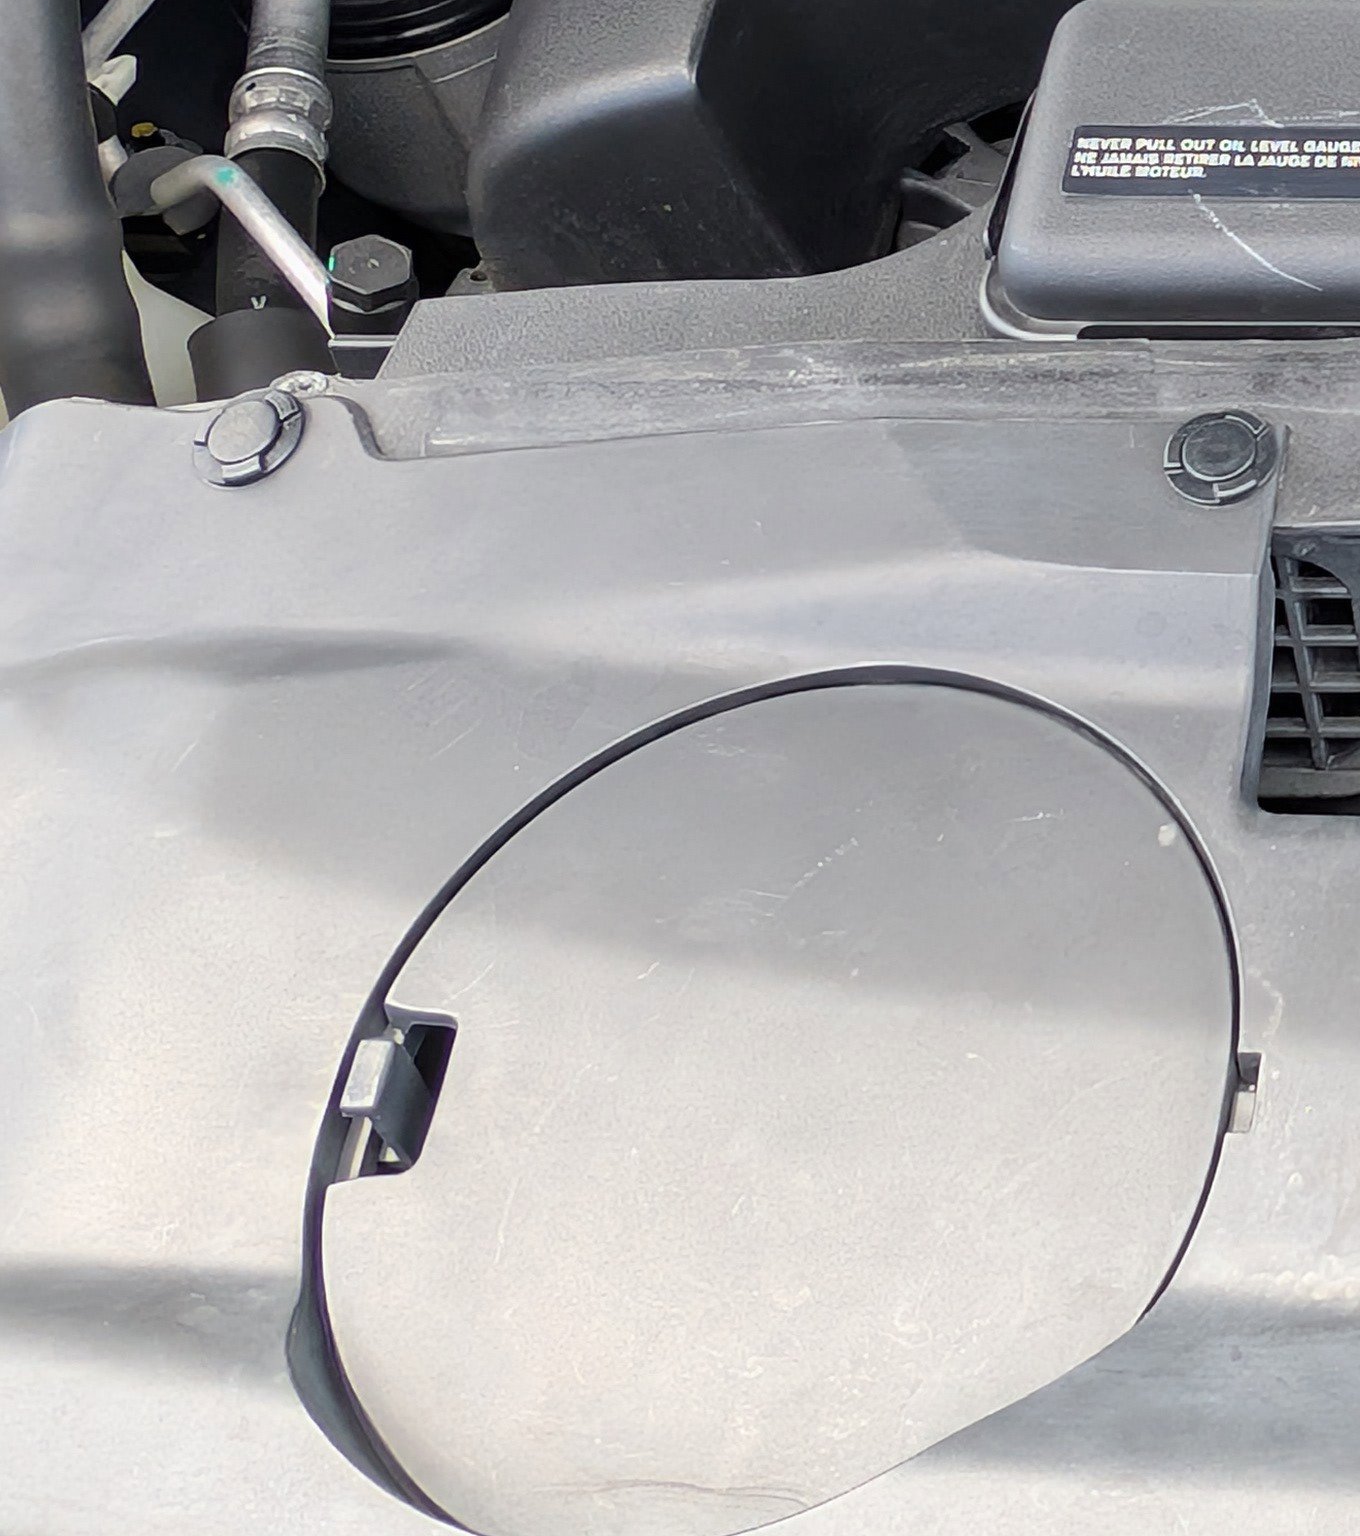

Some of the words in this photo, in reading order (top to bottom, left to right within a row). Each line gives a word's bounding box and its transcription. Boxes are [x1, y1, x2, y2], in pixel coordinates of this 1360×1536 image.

[1135, 139, 1175, 150] PULL
[1180, 139, 1215, 151] OUT
[1251, 141, 1298, 152] LEVEL
[1235, 155, 1255, 166] LA
[1314, 156, 1337, 167] DE
